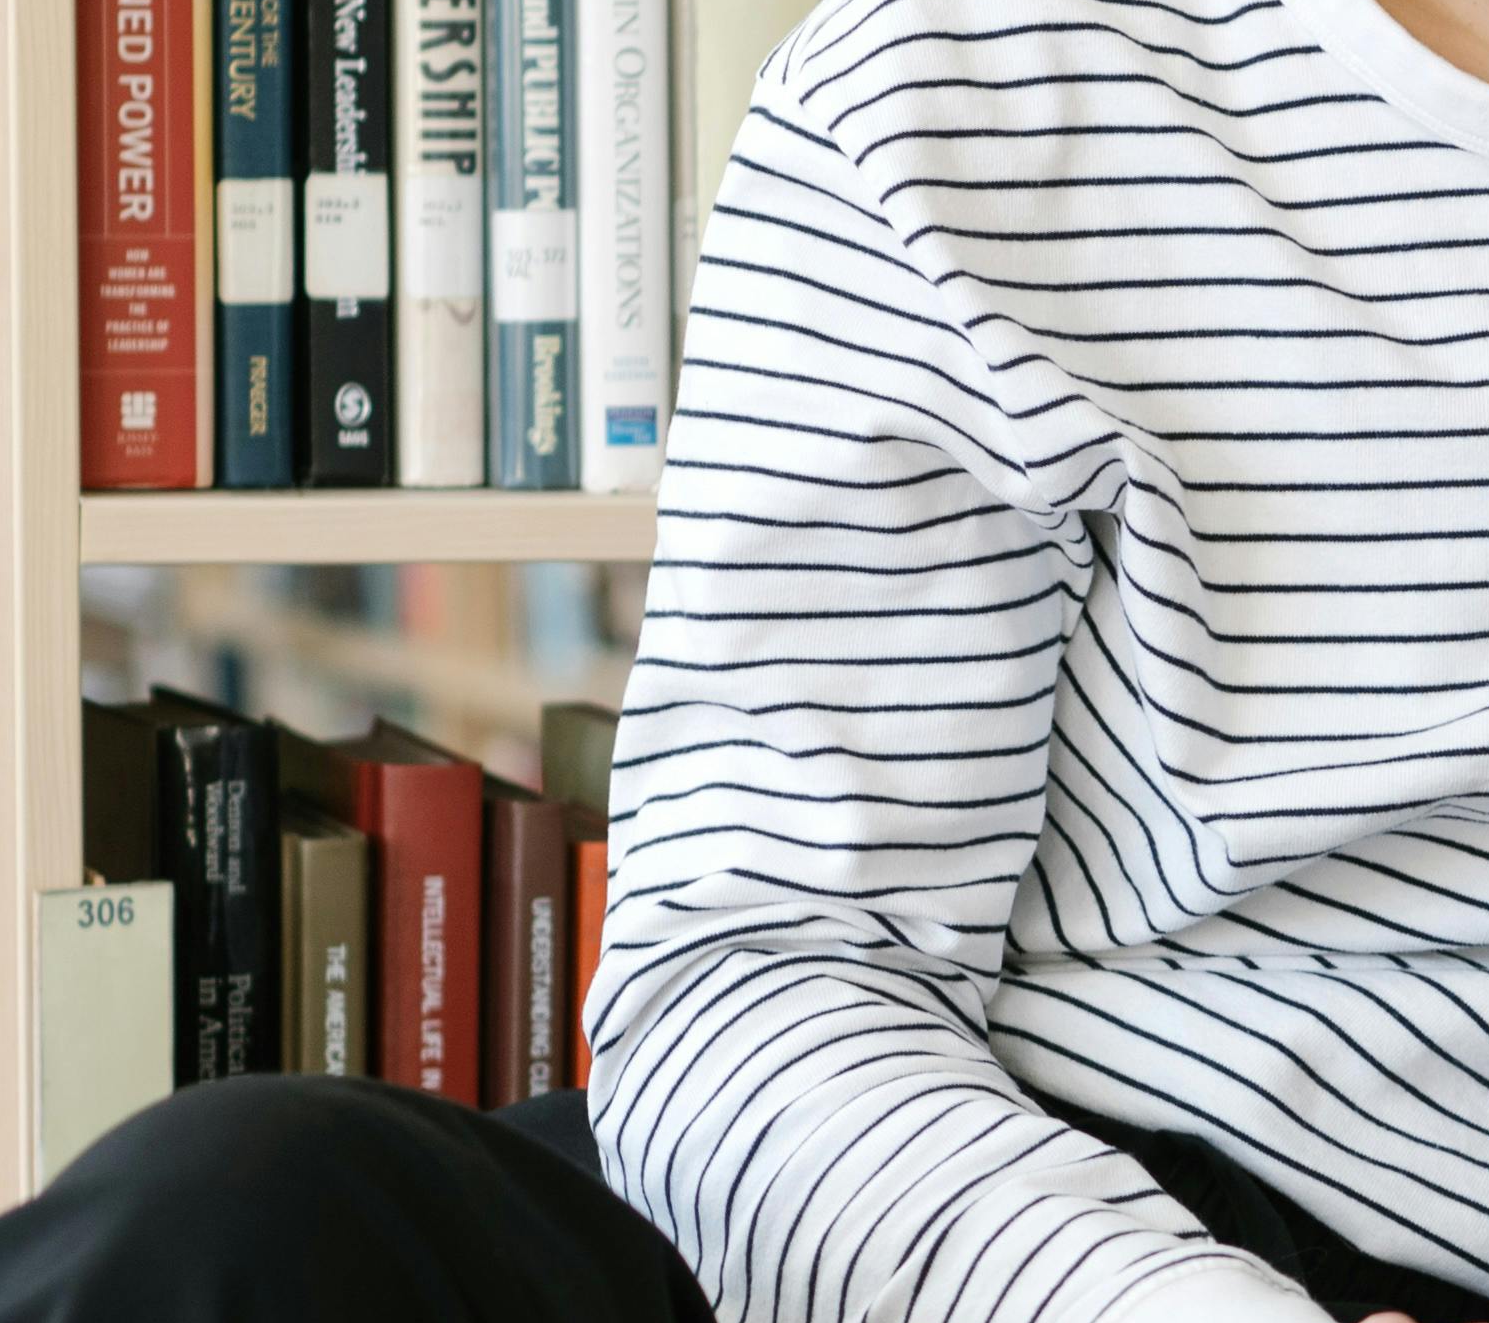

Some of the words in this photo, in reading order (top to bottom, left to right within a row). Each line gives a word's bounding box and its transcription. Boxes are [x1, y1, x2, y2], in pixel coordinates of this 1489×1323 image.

[261, 29, 280, 68] THE
[117, 74, 154, 222] POWER
[613, 46, 648, 332] ORGANIZATIONS
[125, 248, 150, 263] HOW
[100, 284, 175, 299] TRANSFORMING
[106, 320, 152, 335] PRACTICE
[107, 337, 170, 353] LEADERSHIP
[337, 430, 369, 447] SAGE
[76, 896, 136, 929] 306
[325, 942, 348, 985] THE
[420, 875, 445, 1017] INTELLECTUAL
[529, 896, 553, 1058] UNDERSTANDING
[420, 1019, 444, 1063] LIFE
[420, 1067, 443, 1091] IN
